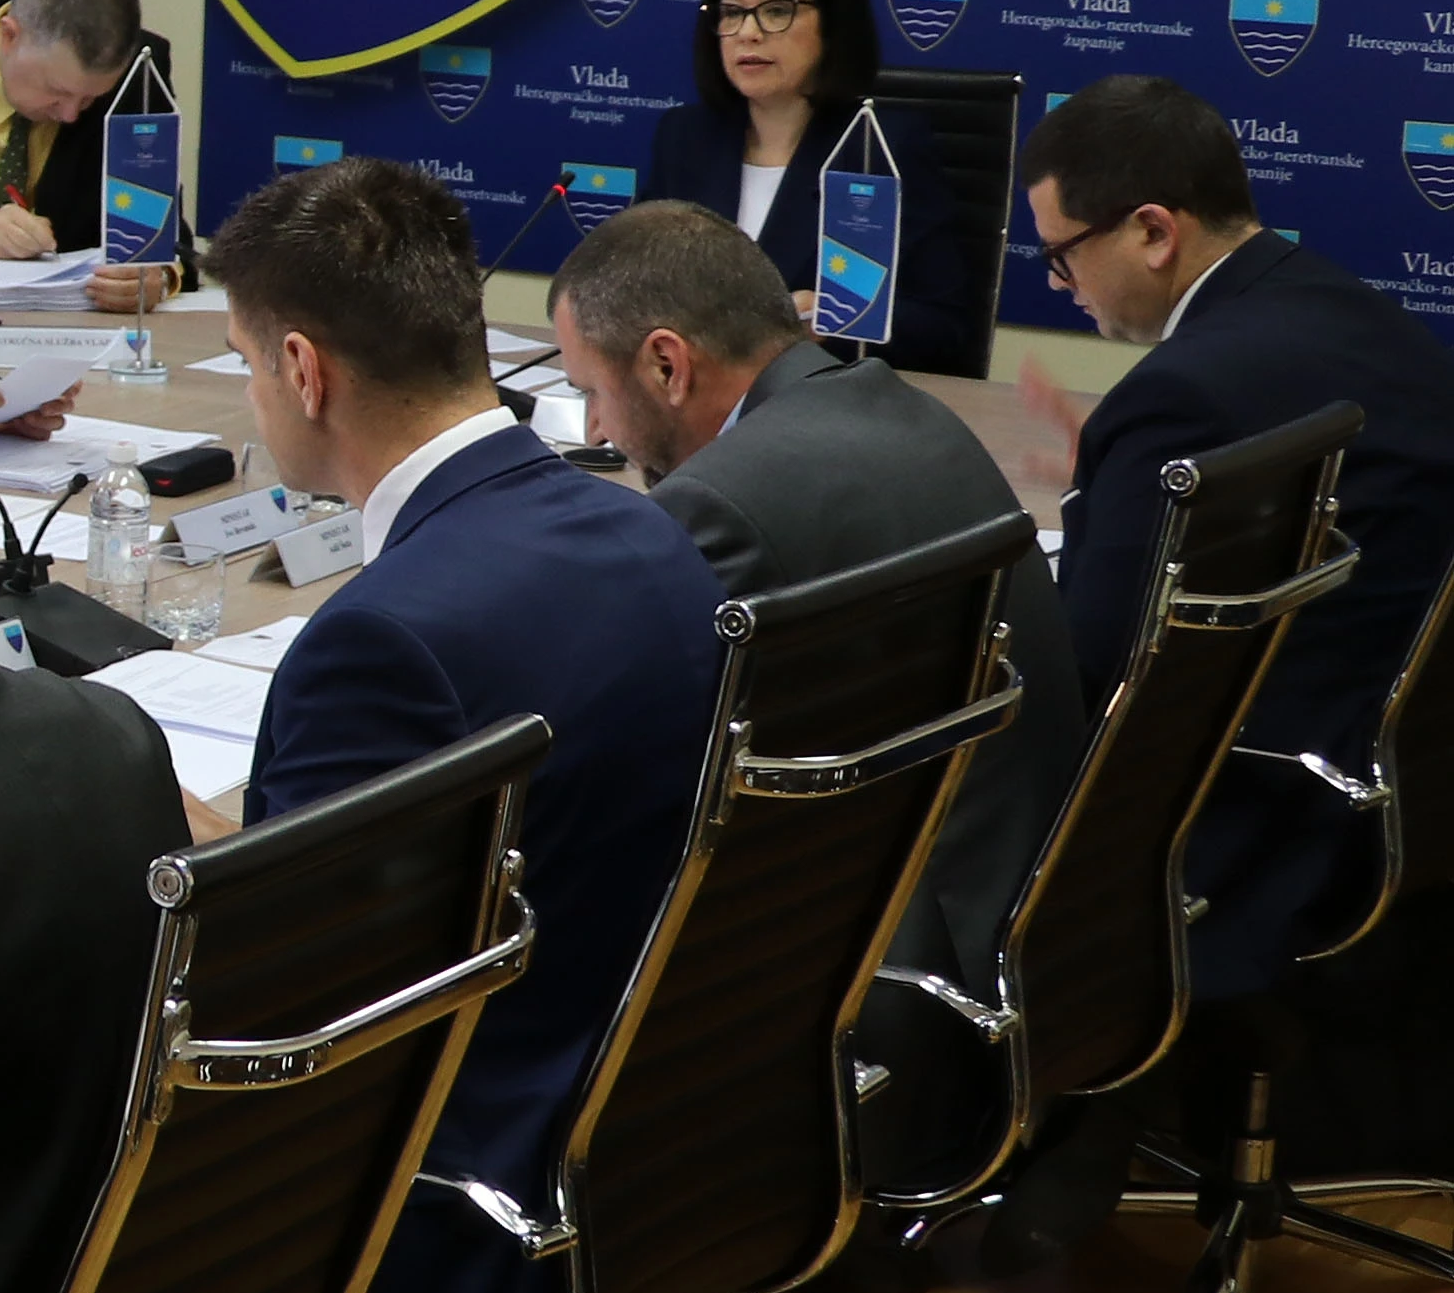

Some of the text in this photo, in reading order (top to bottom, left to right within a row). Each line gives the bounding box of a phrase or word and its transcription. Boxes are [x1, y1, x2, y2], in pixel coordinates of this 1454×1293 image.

[570, 65, 629, 89] Vlada
[1231, 118, 1299, 144] Vlada
[1247, 167, 1293, 184] panije
